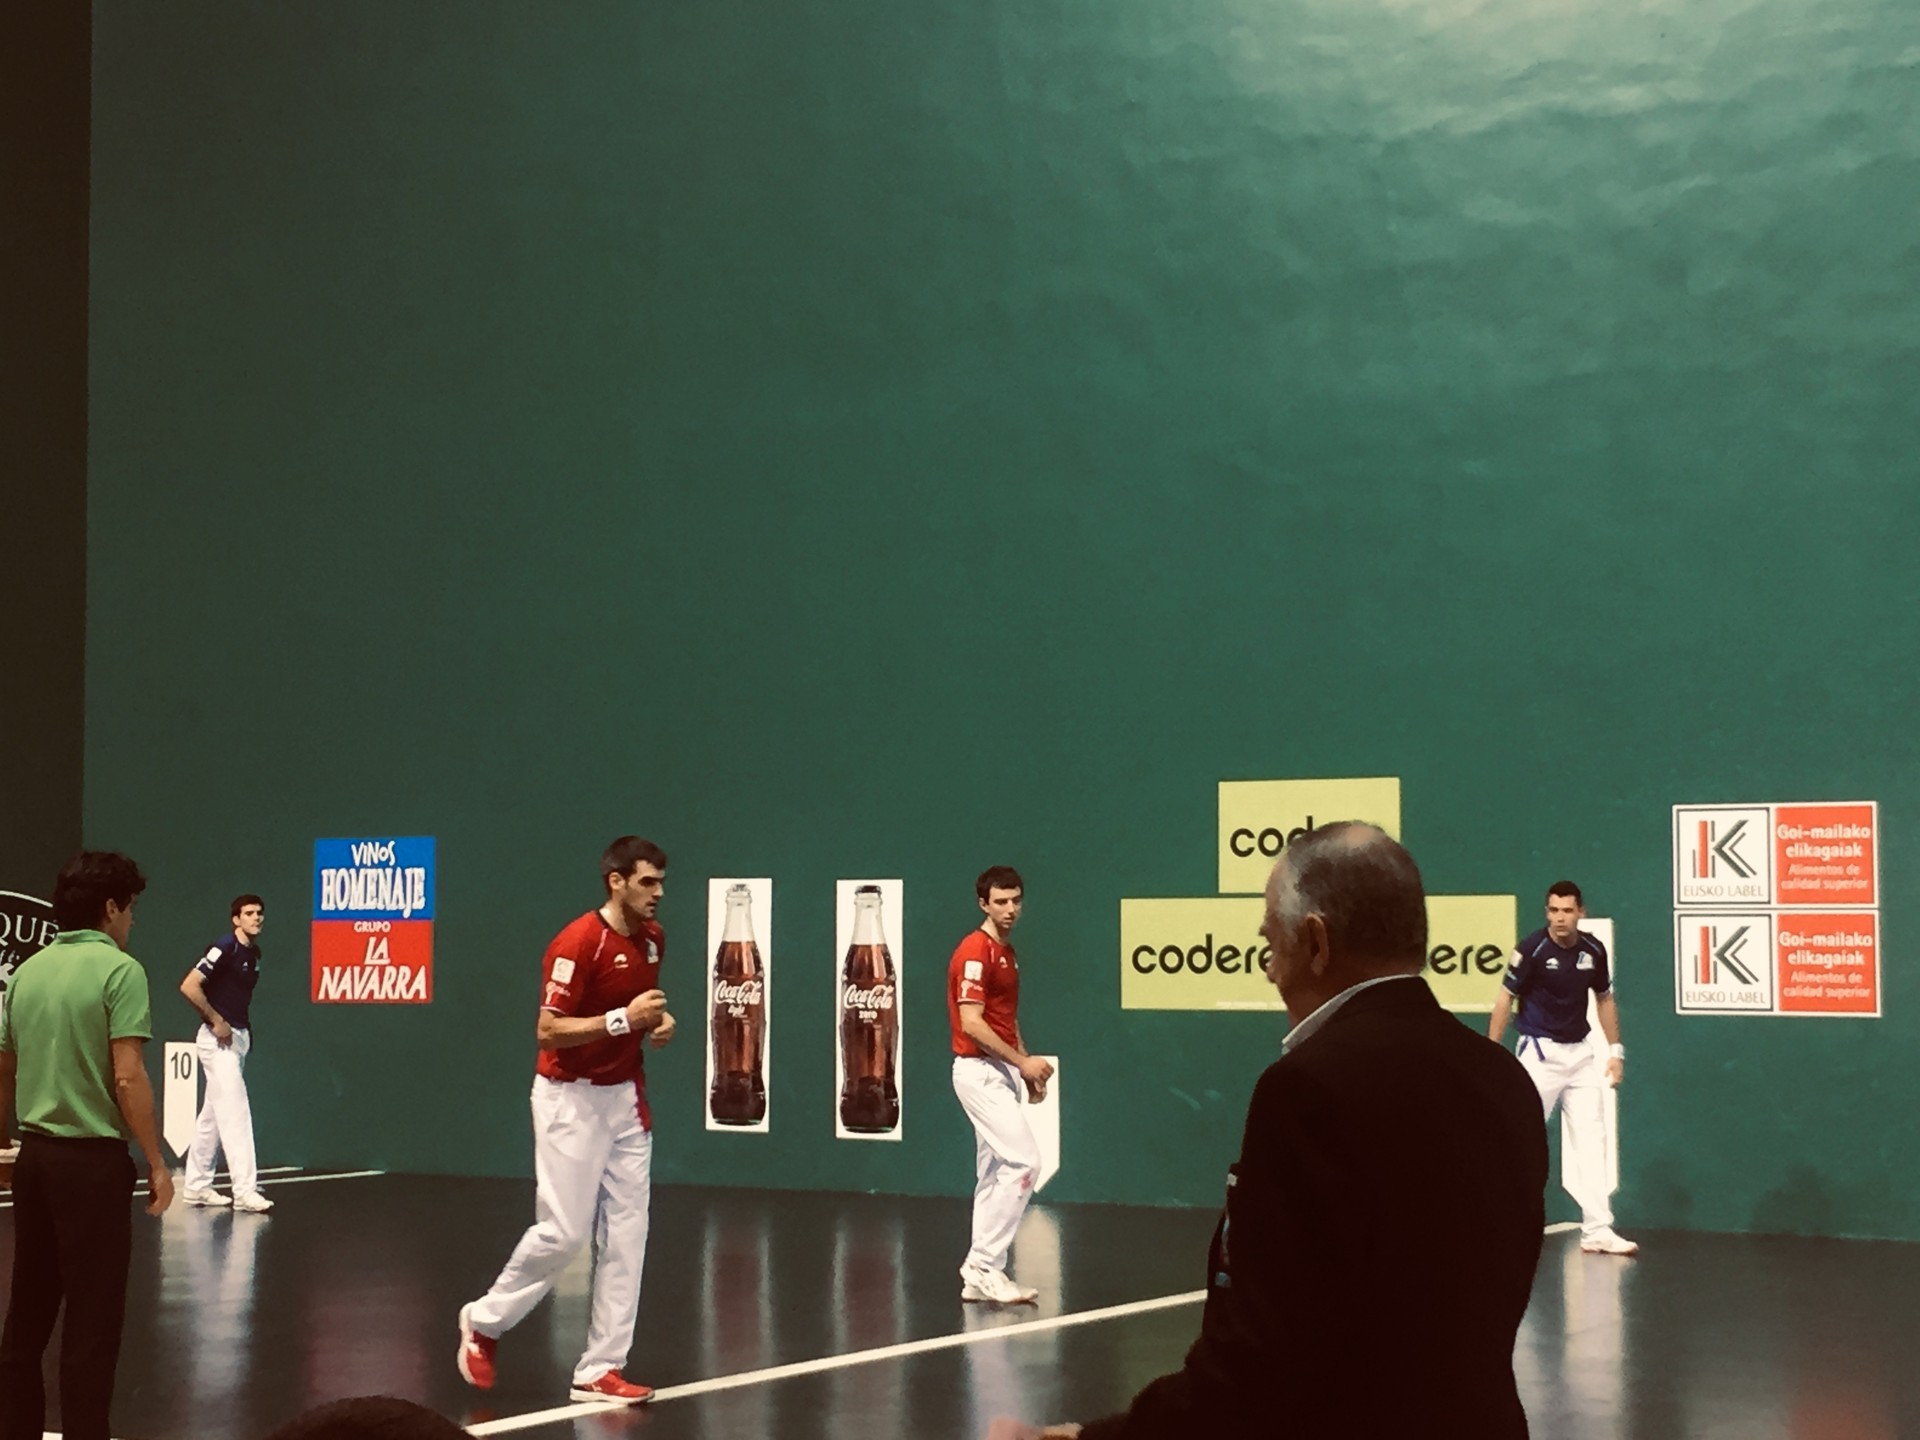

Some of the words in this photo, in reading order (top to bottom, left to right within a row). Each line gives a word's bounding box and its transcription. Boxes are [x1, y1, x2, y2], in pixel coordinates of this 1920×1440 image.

[1230, 815, 1313, 857] cod
[1777, 823, 1871, 839] Goi-mailako
[1785, 842, 1863, 862] elikagaiak
[321, 867, 426, 918] HOMENAJE
[1683, 884, 1724, 897] EUSKO
[1727, 884, 1764, 897] LABEL
[354, 921, 391, 933] GRUPO
[1779, 931, 1873, 947] Goi-mailako
[364, 937, 390, 965] LA
[1430, 944, 1503, 975] ere
[1787, 949, 1864, 969] elikagaiak
[318, 965, 427, 1000] NAVARRA
[1686, 991, 1726, 1003] EUSKO
[1729, 991, 1766, 1003] LABEL
[171, 1051, 192, 1080] 10
